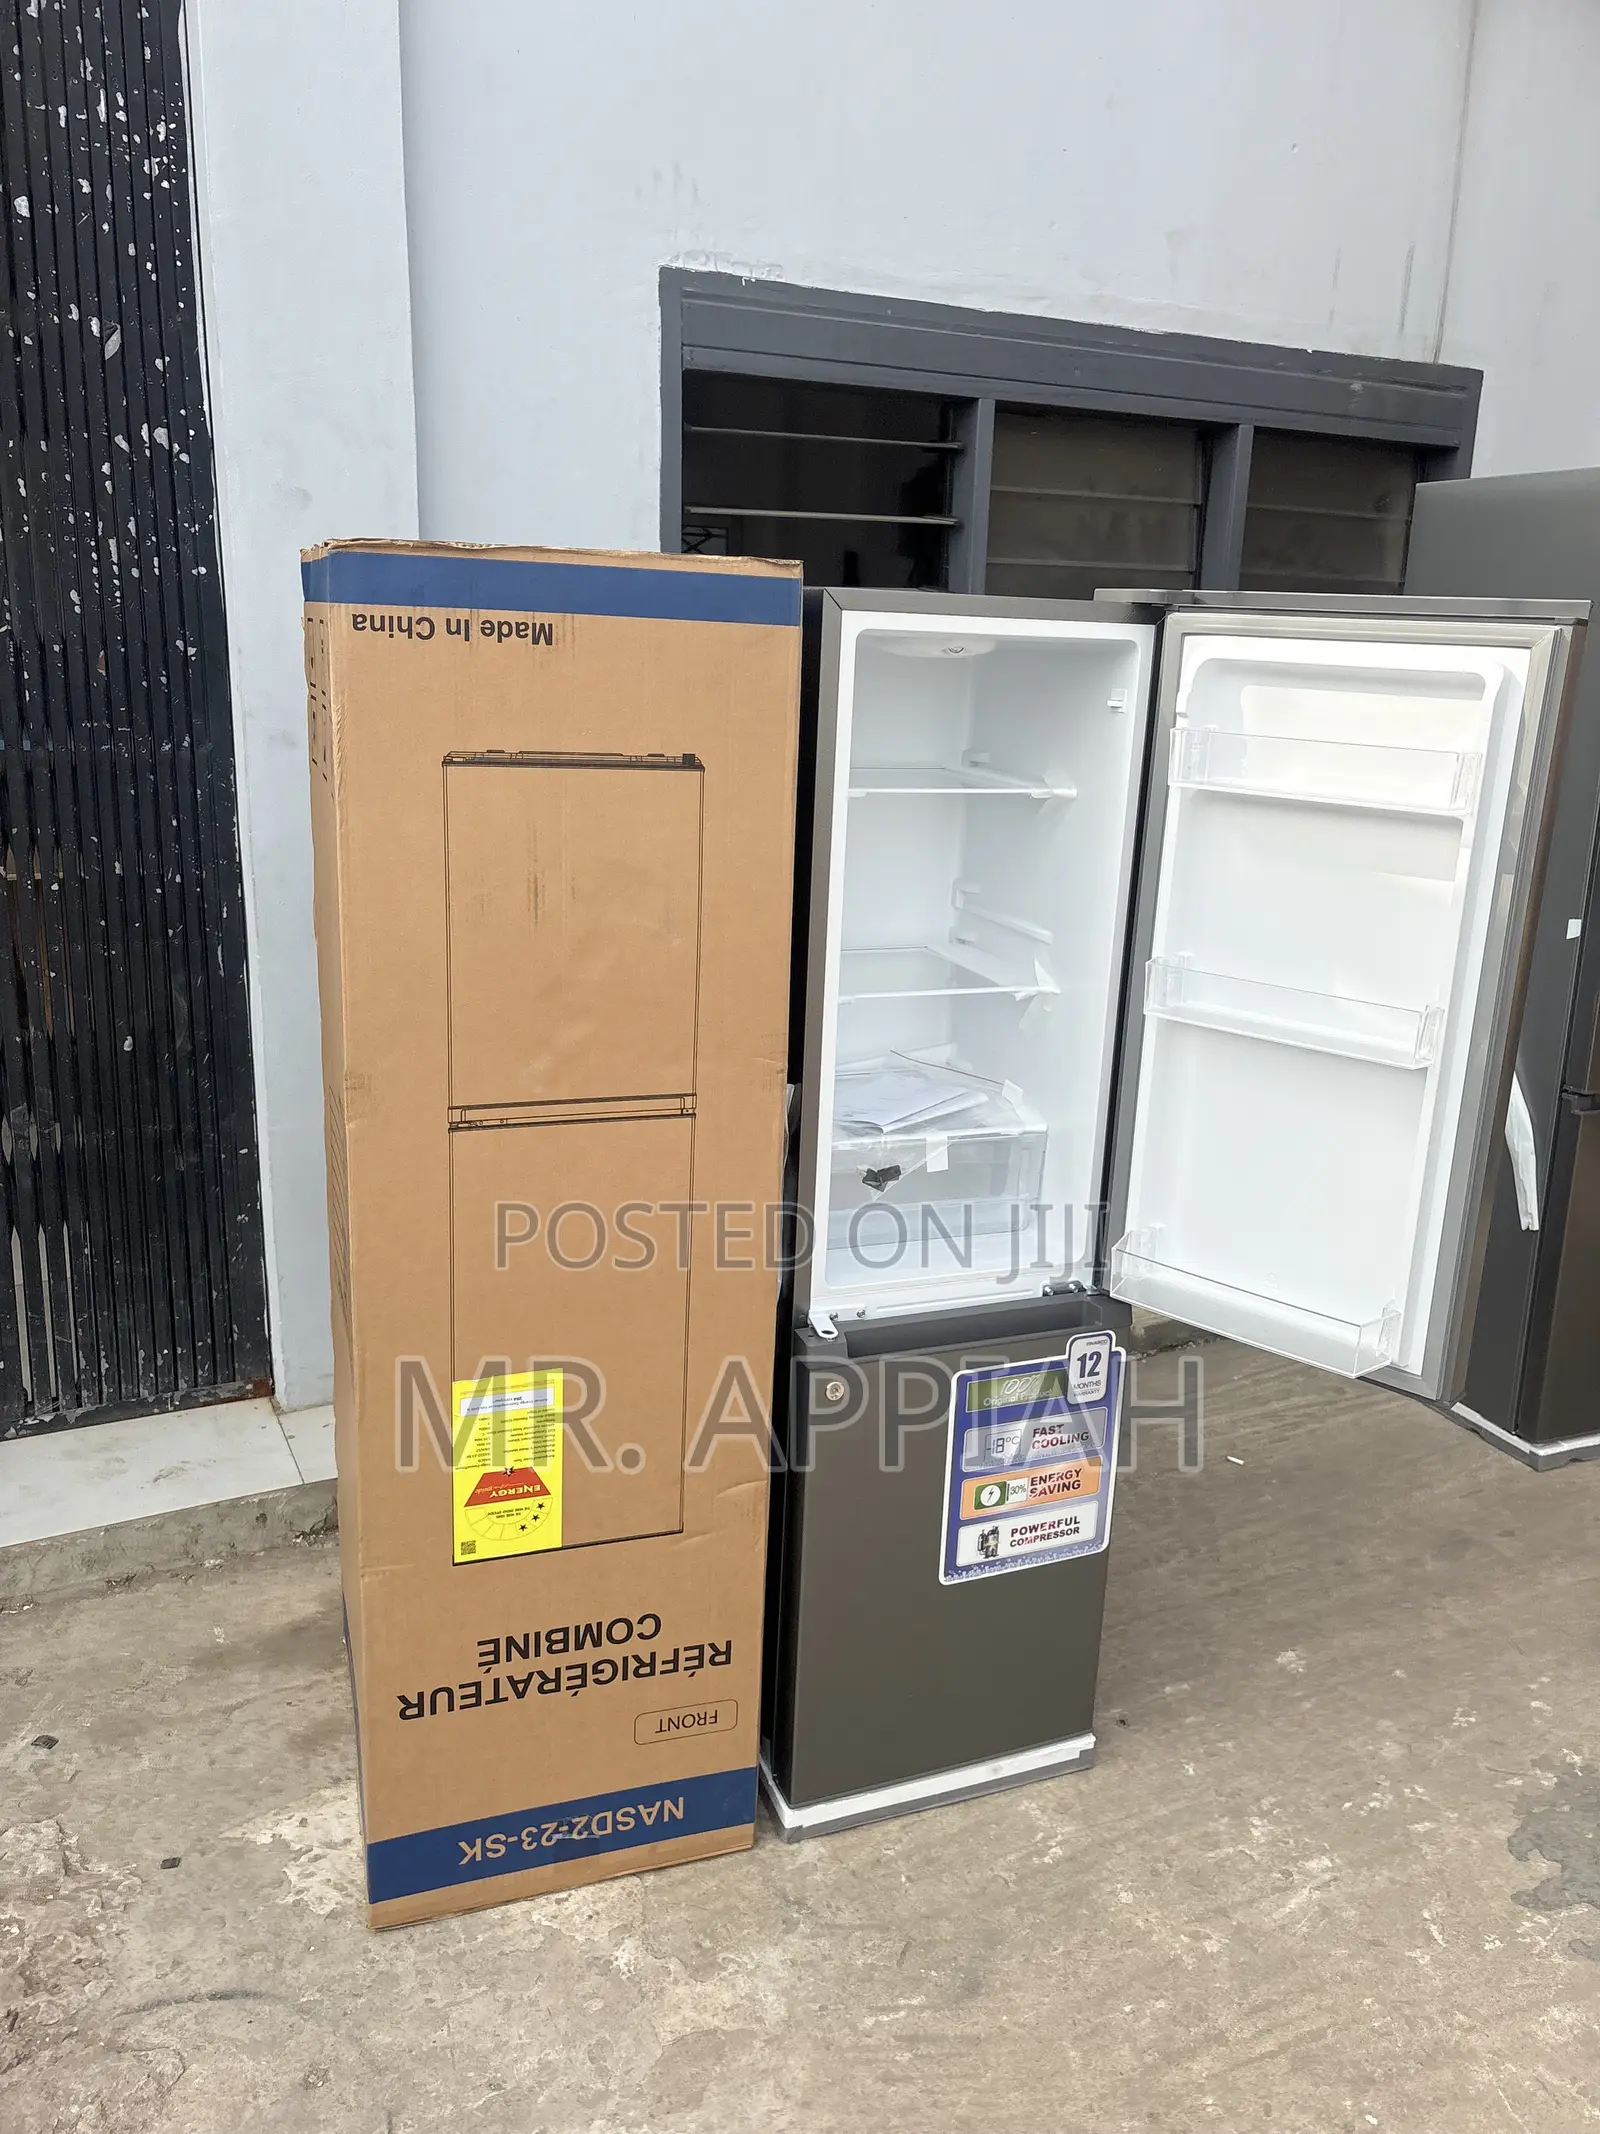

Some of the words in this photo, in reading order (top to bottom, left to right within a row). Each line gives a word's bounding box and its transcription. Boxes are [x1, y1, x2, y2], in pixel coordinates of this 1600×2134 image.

[352, 613, 435, 641] China
[446, 617, 470, 642] In
[482, 619, 553, 646] Made
[1077, 1350, 1102, 1379] 12
[1074, 1380, 1102, 1390] MONTHS
[983, 1393, 1019, 1407] Original
[1031, 1431, 1090, 1450] COOLING
[1032, 1423, 1065, 1438] FAST
[1030, 1468, 1083, 1487] ENERGY
[489, 1484, 541, 1498] ENERGY
[1010, 1483, 1027, 1496] 30%
[1029, 1480, 1081, 1498] SAVING
[1010, 1515, 1081, 1538] POWERFUL
[1010, 1526, 1080, 1548] COMPRESSOR
[477, 1612, 662, 1673] COMBINÉ
[396, 1640, 732, 1721] RÉFRIGÉRATEUR
[655, 1709, 719, 1734] FRONT
[457, 1796, 685, 1866] NASD2-23-SK
